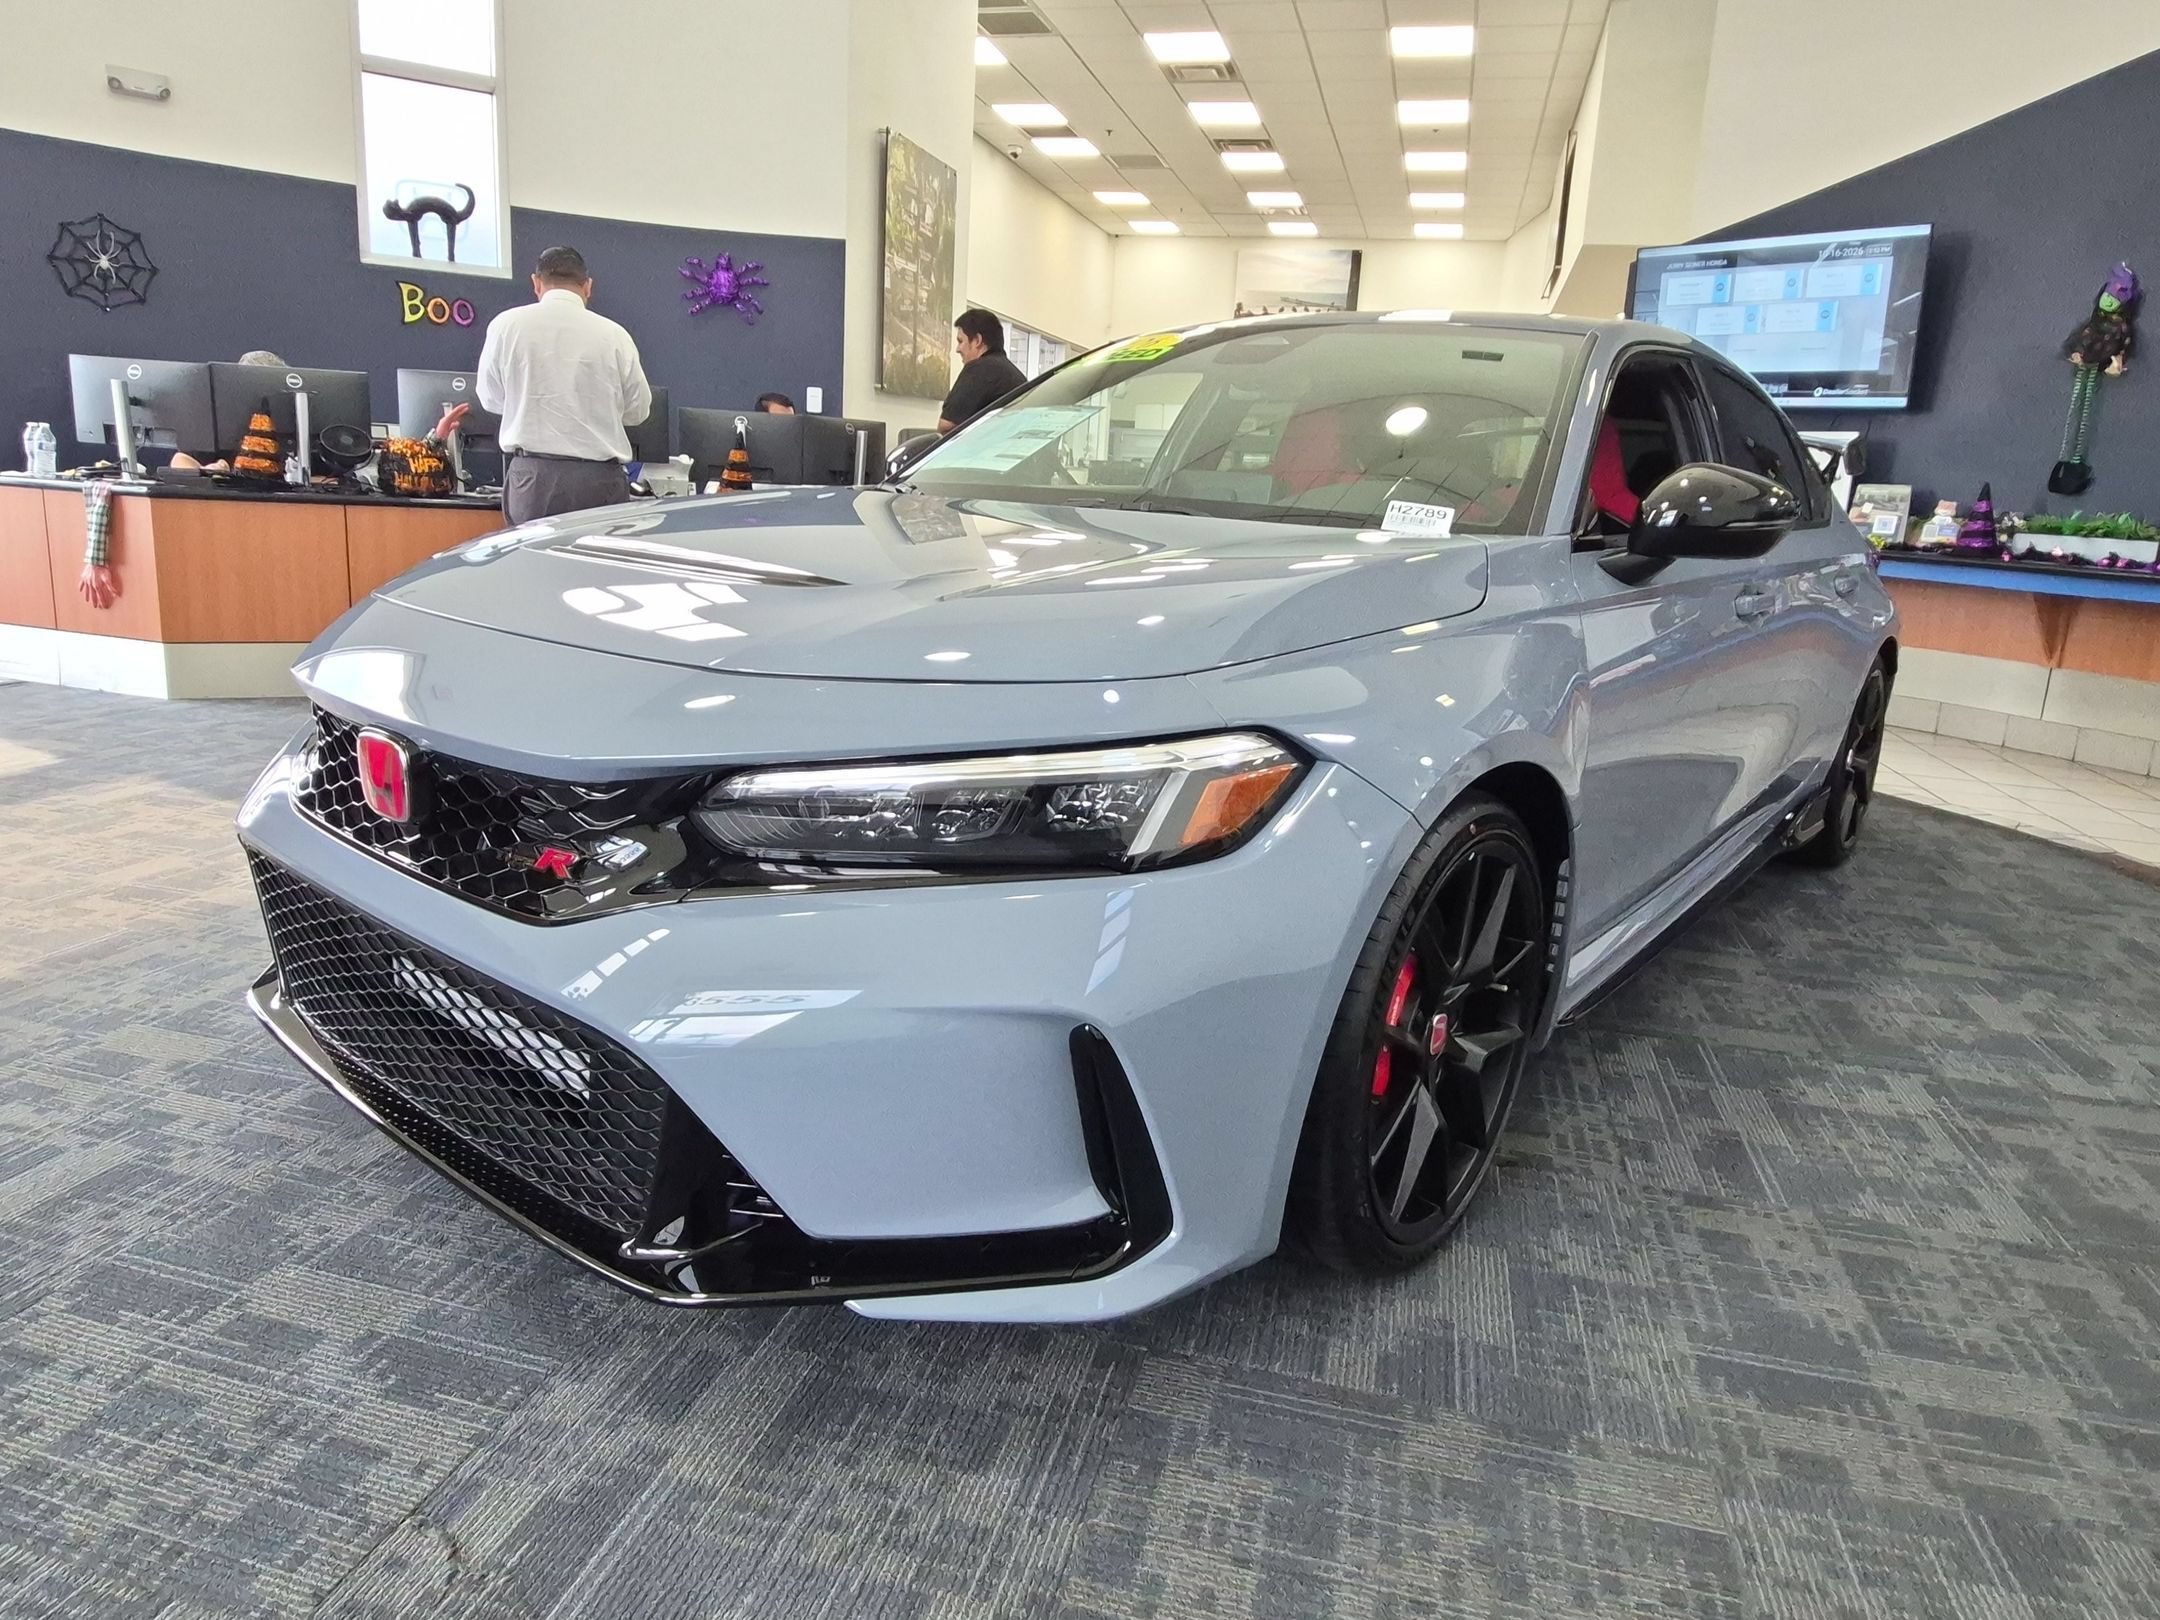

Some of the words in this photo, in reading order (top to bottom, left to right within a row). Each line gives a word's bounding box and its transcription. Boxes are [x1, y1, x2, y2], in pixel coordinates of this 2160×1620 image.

[1819, 247, 1864, 258] 1016-2026
[408, 456, 444, 474] HAPPY
[1390, 503, 1448, 520] H2789
[534, 846, 579, 880] R
